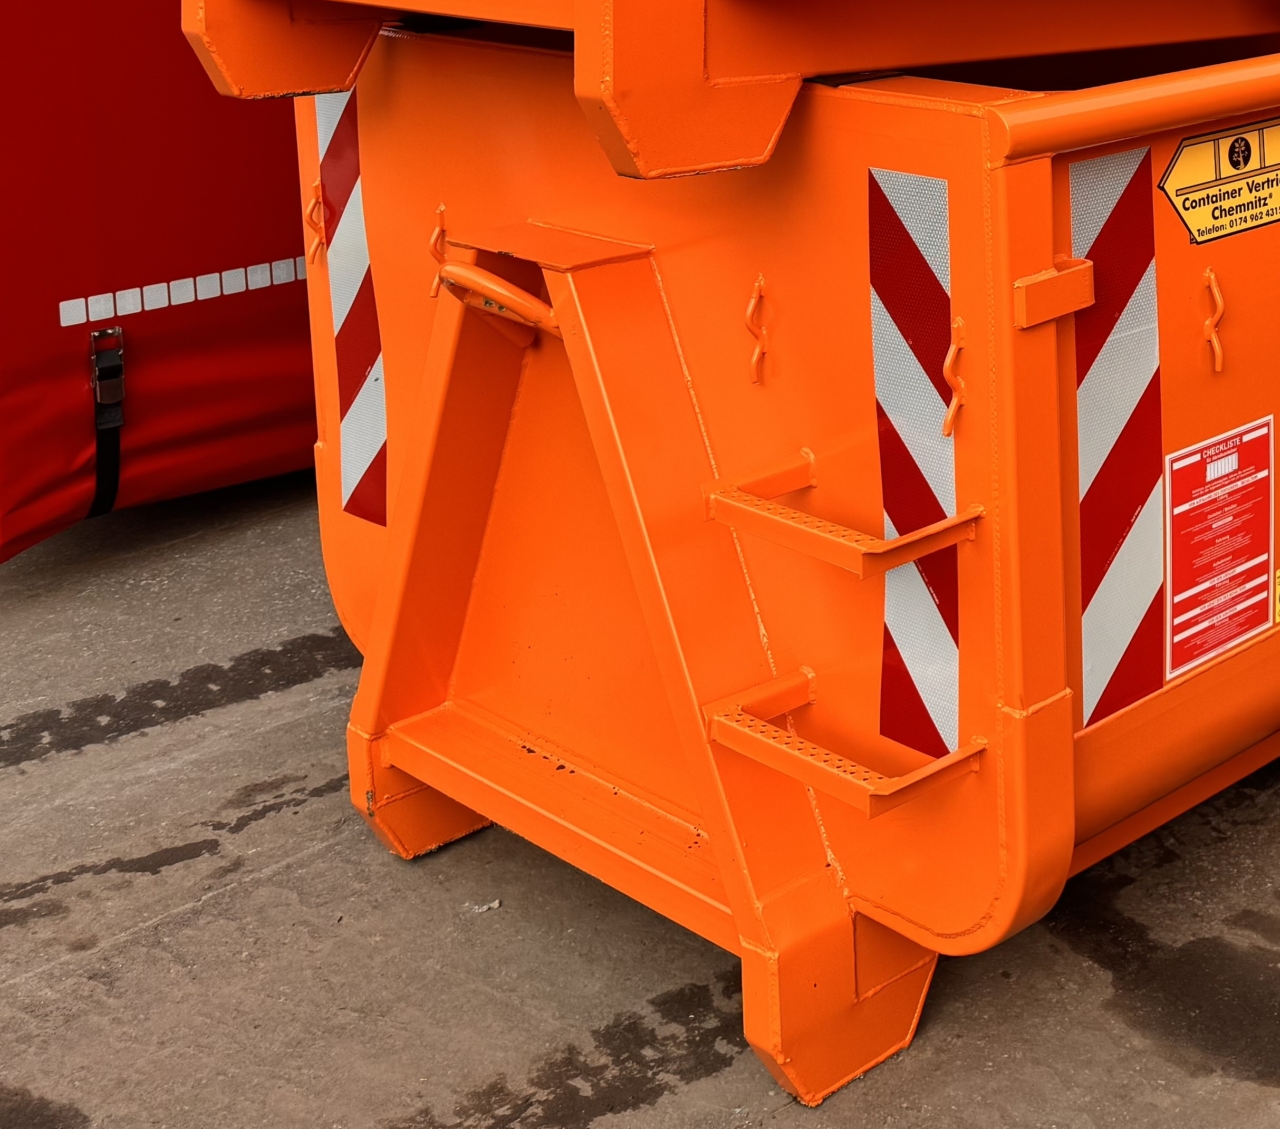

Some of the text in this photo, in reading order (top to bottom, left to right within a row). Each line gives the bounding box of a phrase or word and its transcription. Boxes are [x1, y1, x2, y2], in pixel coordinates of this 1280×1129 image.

[1182, 187, 1243, 211] Container
[1196, 223, 1228, 238] Telefon:
[1229, 217, 1248, 229] 0174
[1249, 211, 1264, 223] 962
[1202, 436, 1241, 458] CHECKLISTE
